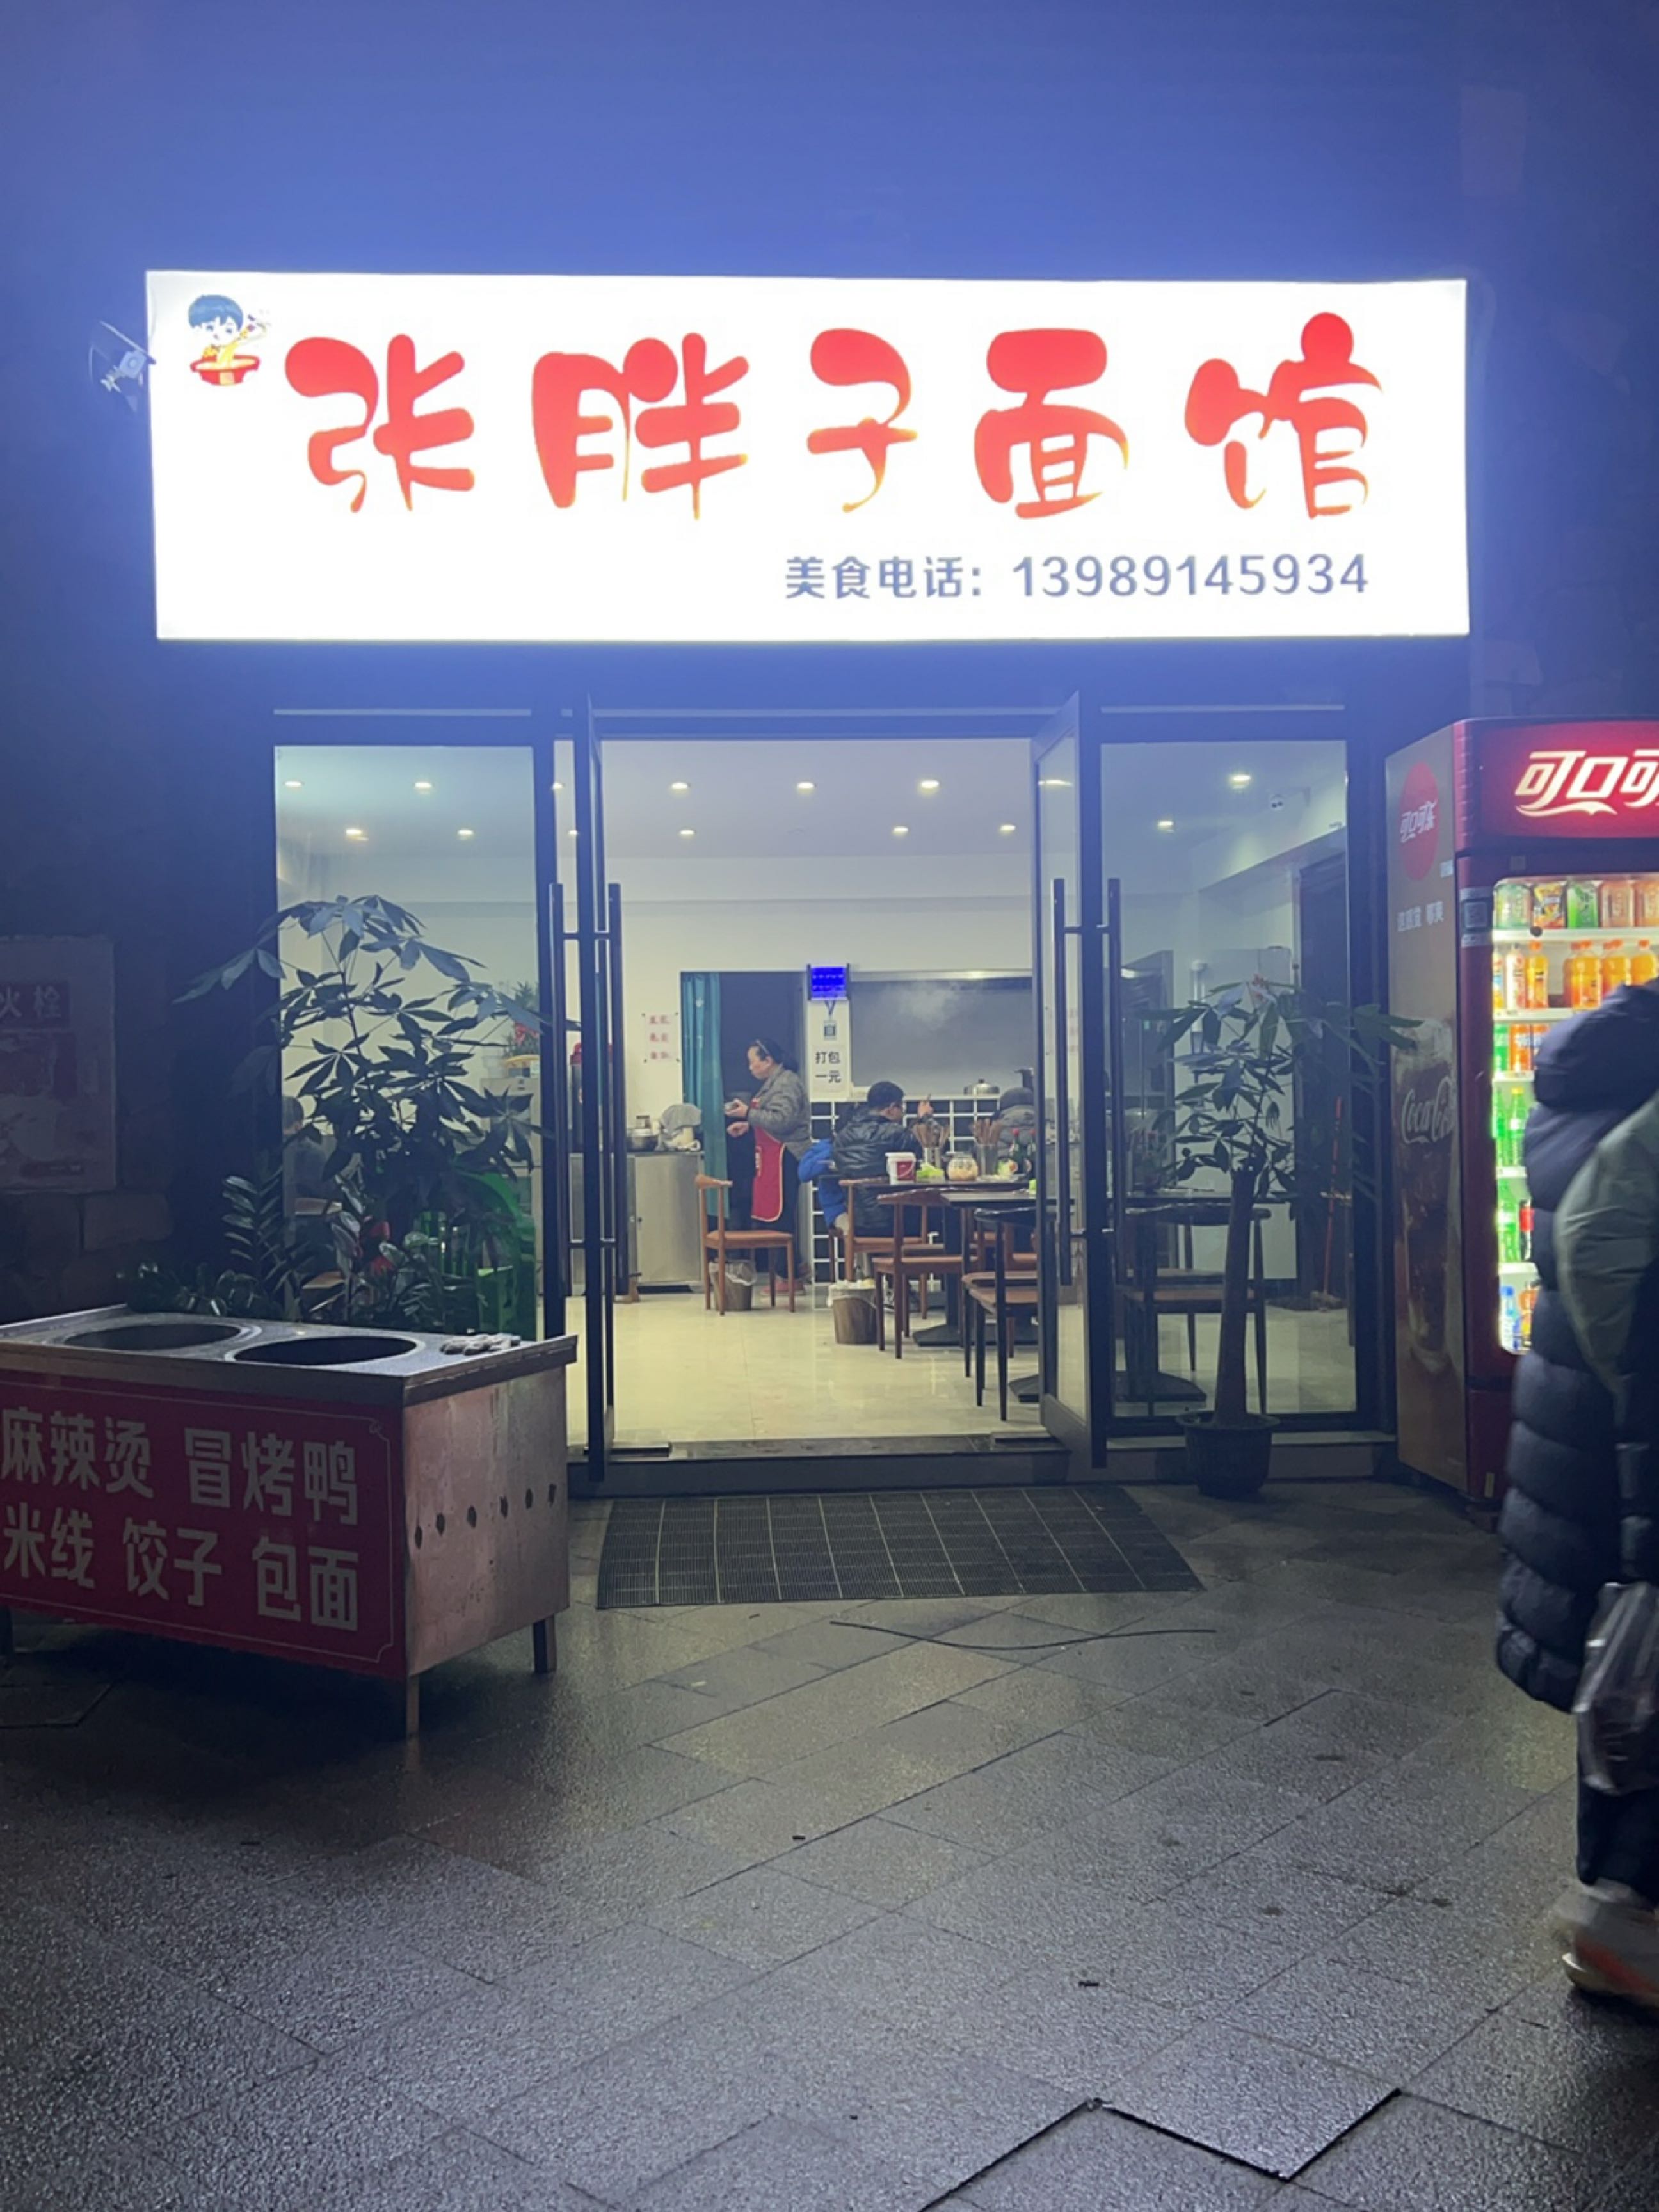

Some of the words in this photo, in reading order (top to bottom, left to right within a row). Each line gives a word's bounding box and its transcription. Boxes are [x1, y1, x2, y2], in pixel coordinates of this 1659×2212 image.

[285, 312, 1381, 520] 张胖子面馆
[1013, 554, 1368, 597] 13989145934
[815, 1051, 840, 1064] 打包
[815, 1070, 842, 1084] 一元
[1, 1406, 154, 1499] 麻辣烫
[184, 1427, 358, 1526] 冒烤鸭
[3, 1502, 97, 1589] 米线
[122, 1516, 223, 1607] 饺子
[252, 1536, 360, 1632] 包面
